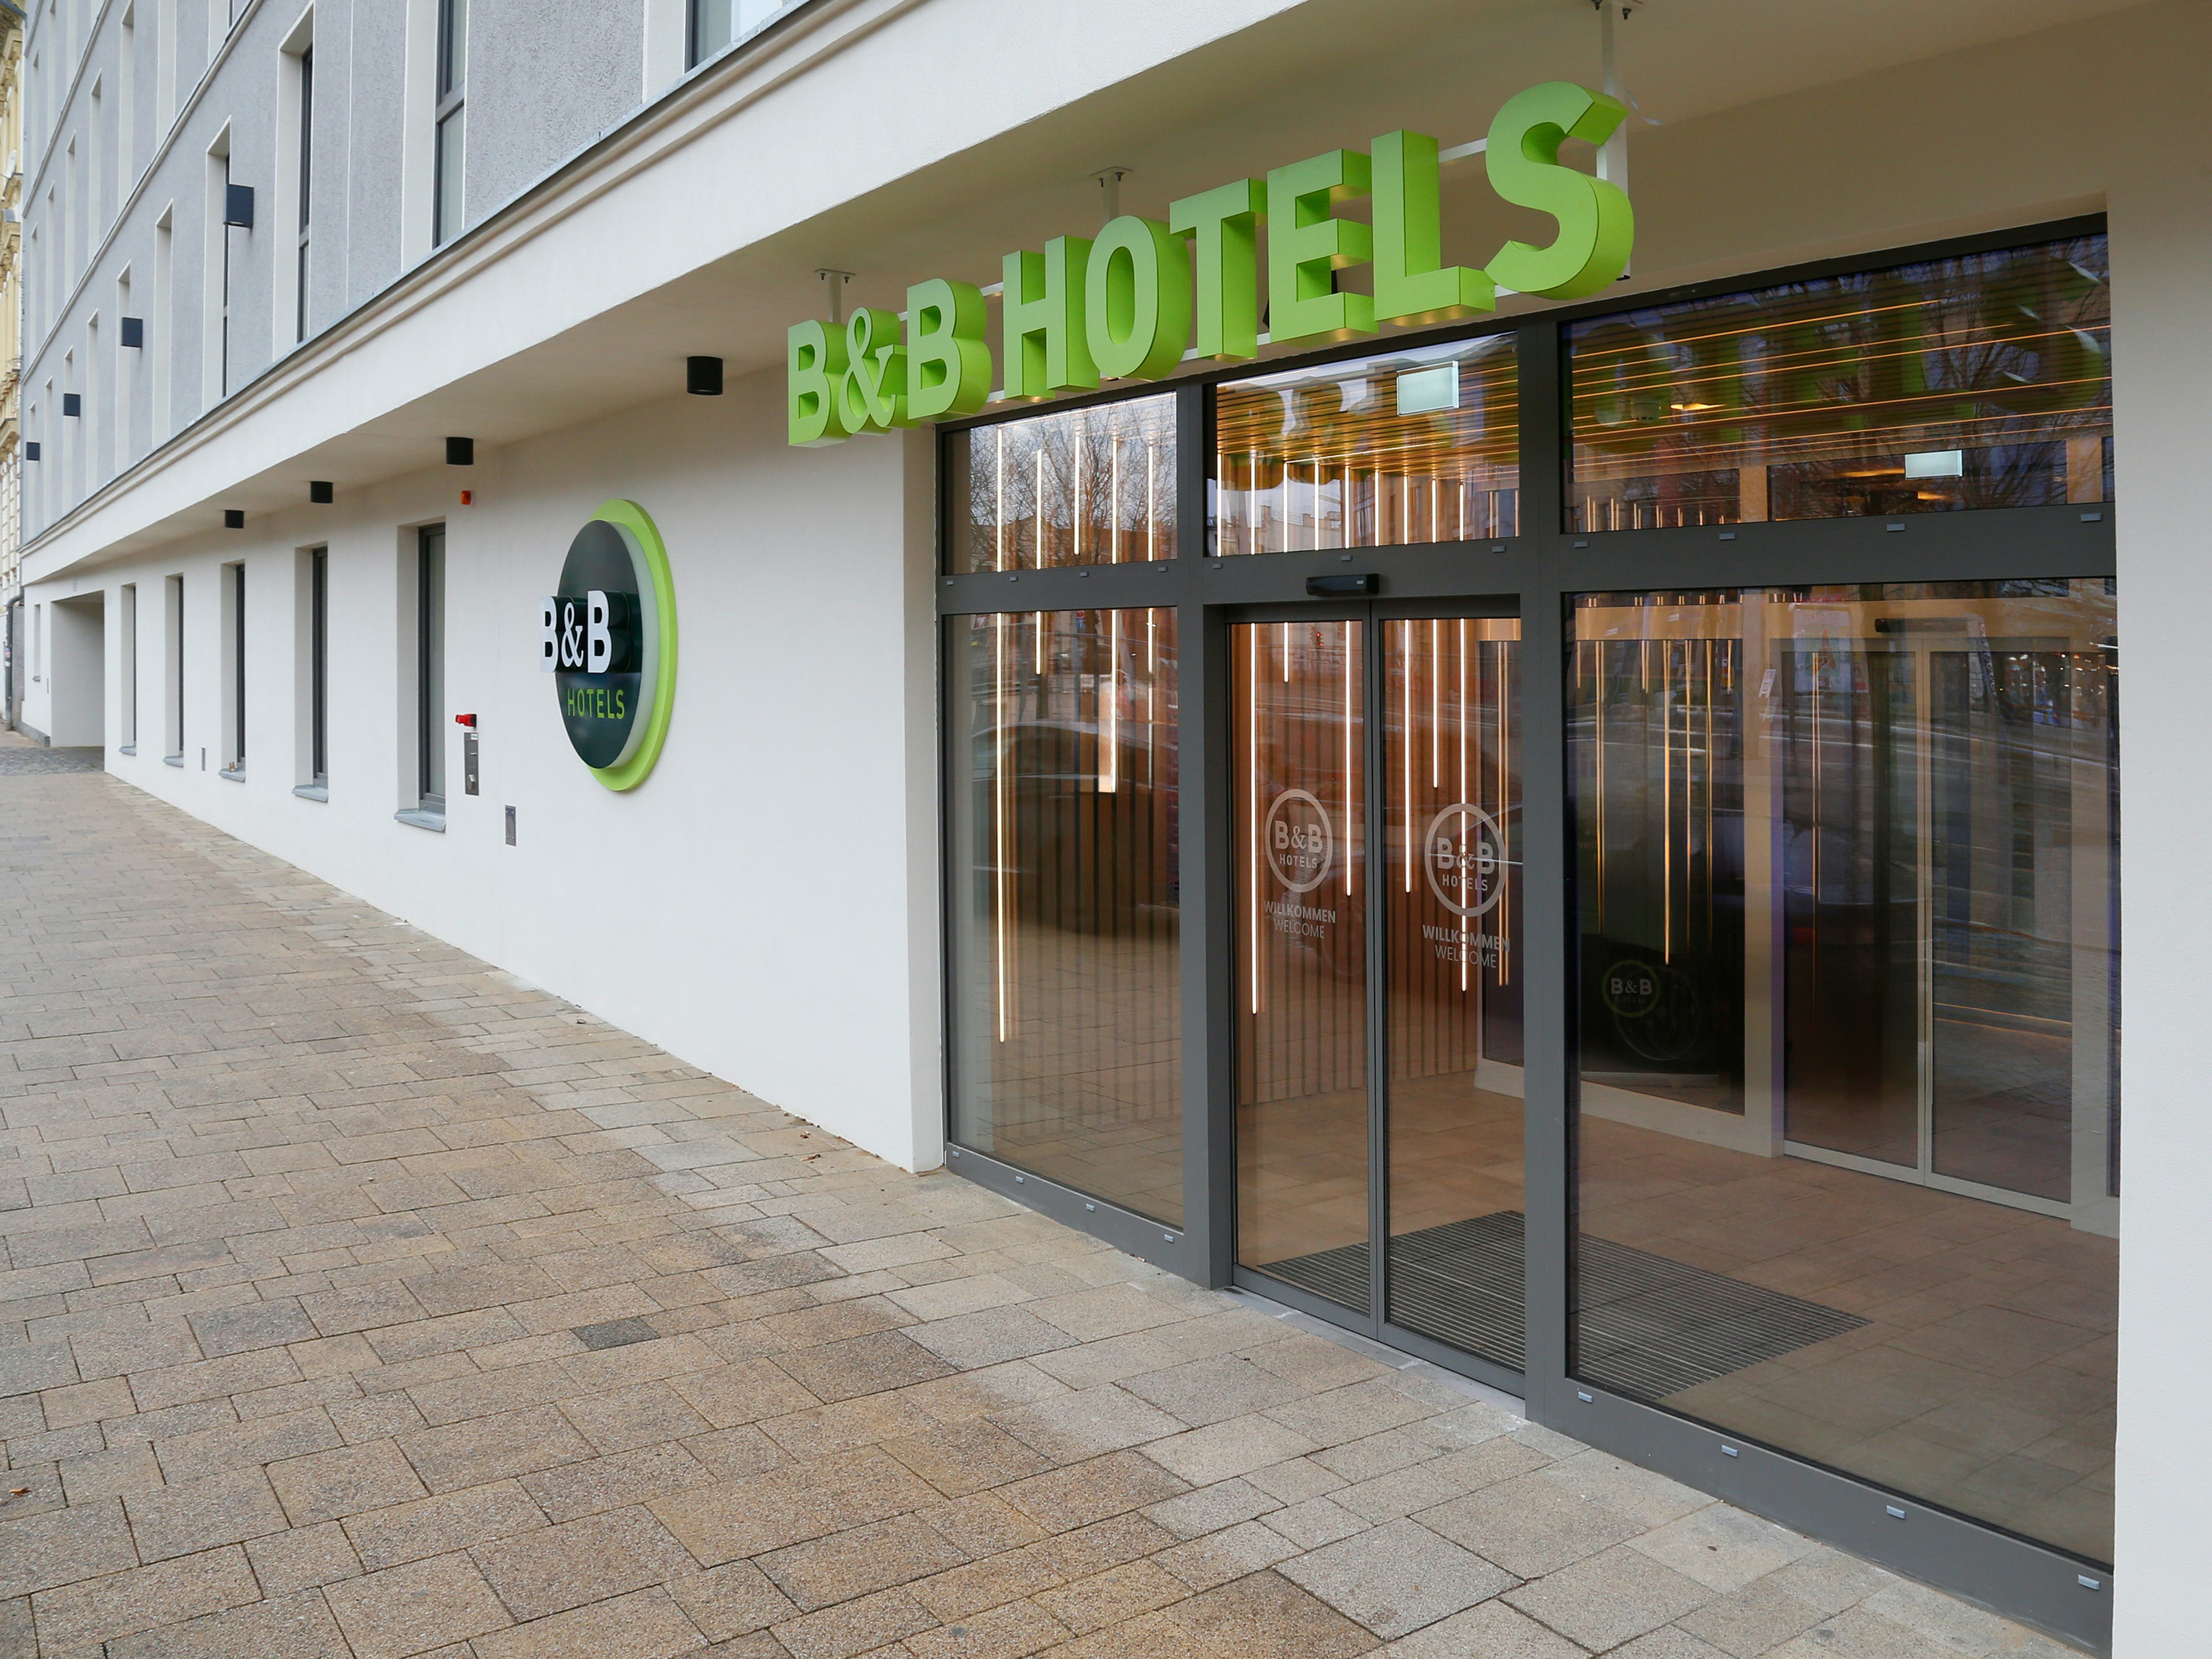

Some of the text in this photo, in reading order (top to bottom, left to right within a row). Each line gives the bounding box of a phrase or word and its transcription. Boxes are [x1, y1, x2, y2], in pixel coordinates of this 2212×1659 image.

[788, 80, 1634, 448] B&B HOTELS
[540, 589, 612, 674] B&B
[567, 687, 625, 719] HOTELS
[1275, 820, 1323, 854] B&B
[1279, 853, 1318, 869] HOTELS
[1437, 837, 1496, 875] B&B
[1264, 900, 1337, 924] WILLKOMMEN
[1274, 917, 1325, 938] WELCOME
[1422, 924, 1510, 952] WILLKOMMEN
[1610, 978, 1653, 995] B&B
